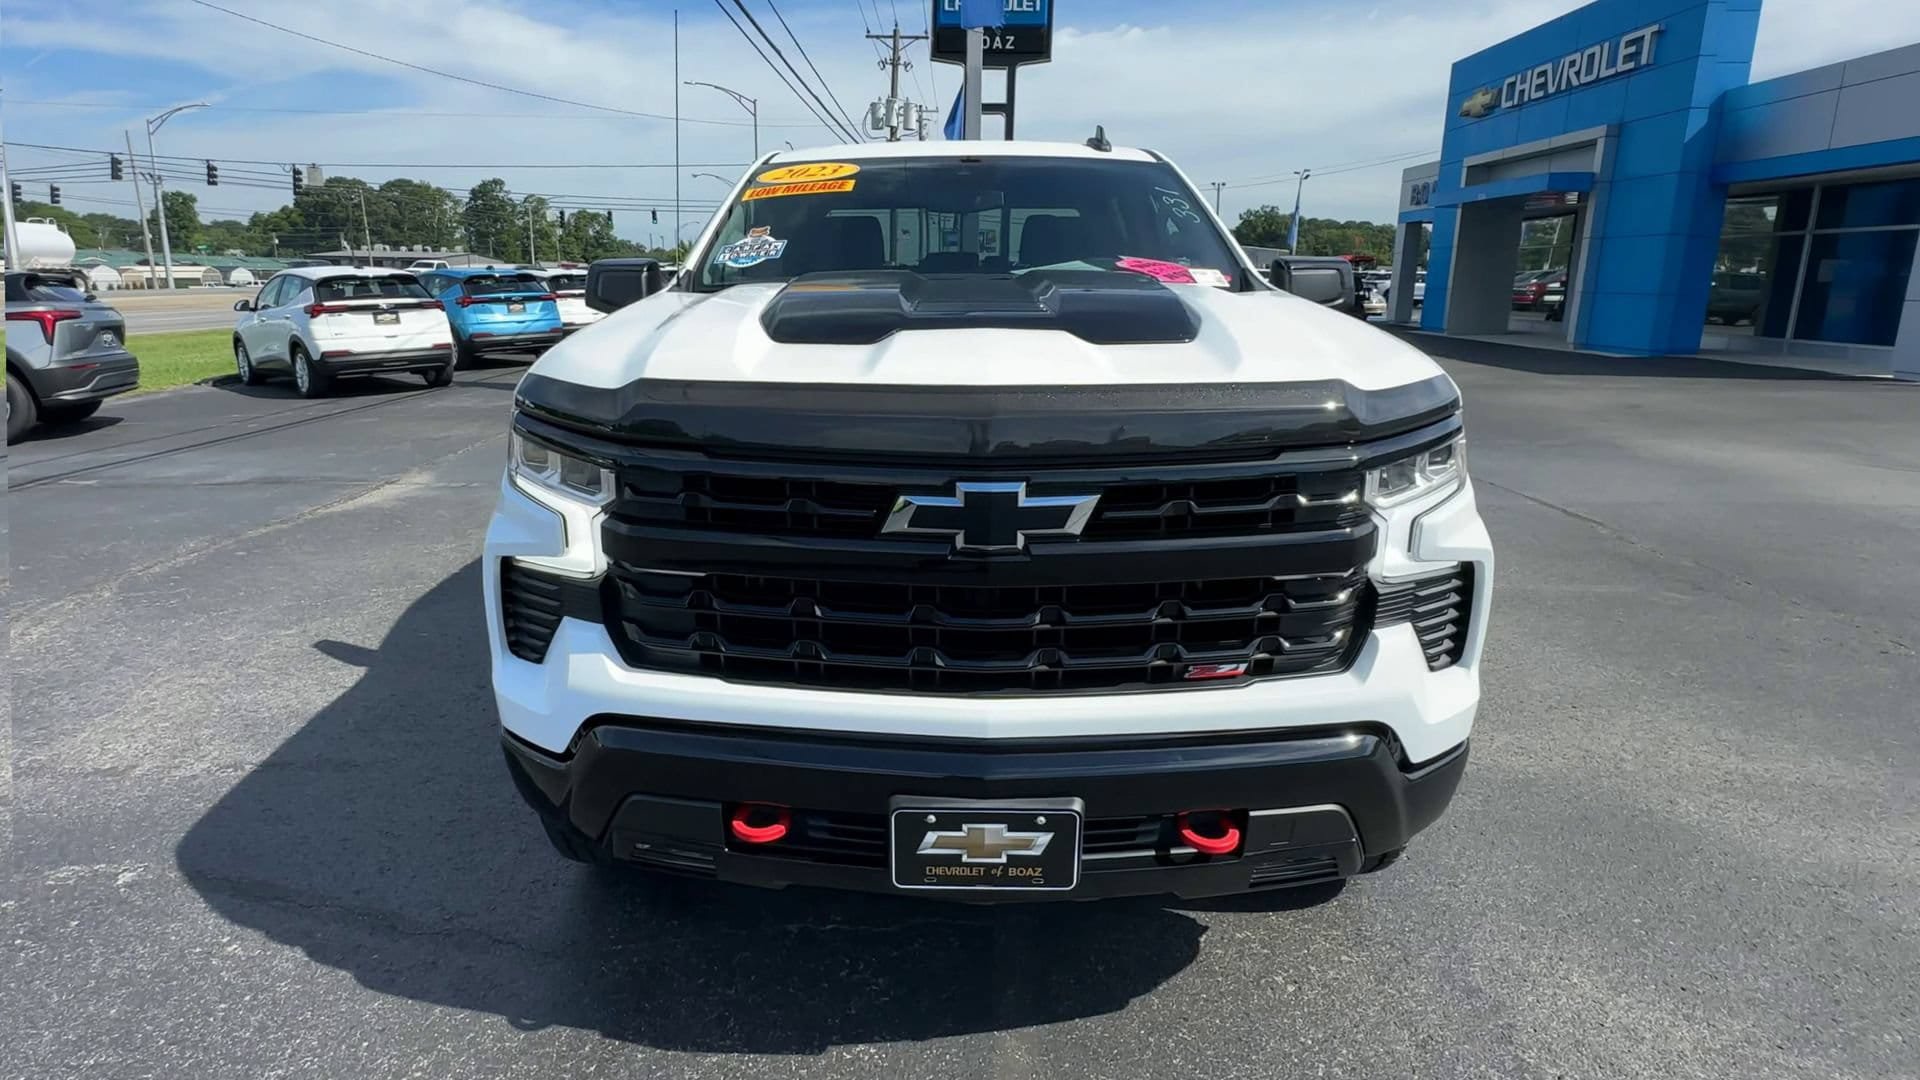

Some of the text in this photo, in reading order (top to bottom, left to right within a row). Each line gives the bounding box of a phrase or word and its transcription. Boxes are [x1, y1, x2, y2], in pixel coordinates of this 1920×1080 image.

[982, 36, 1015, 49] OAZ
[1501, 24, 1660, 109] CHEVROLET
[773, 165, 844, 180] 2023
[748, 181, 850, 198] LOW MILEAGE
[926, 866, 1042, 877] CHEVROLET of BOAZ
